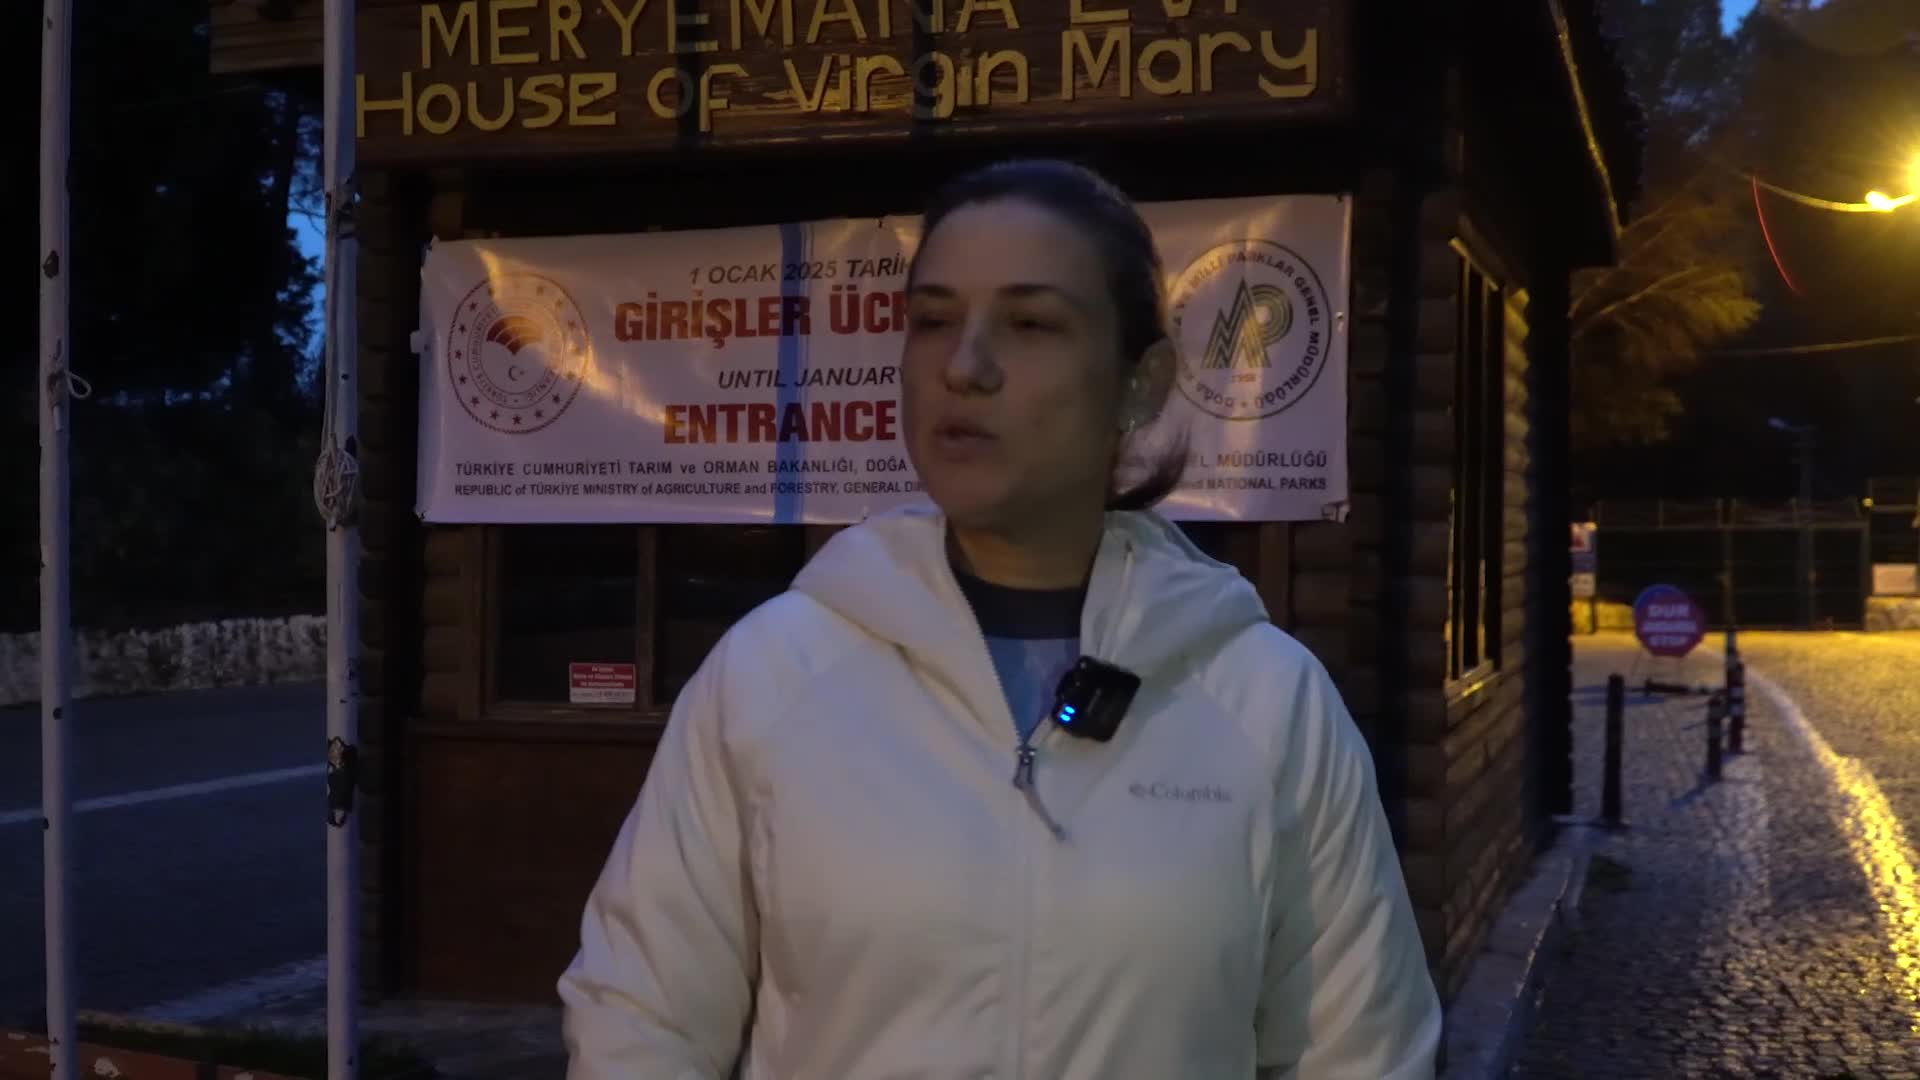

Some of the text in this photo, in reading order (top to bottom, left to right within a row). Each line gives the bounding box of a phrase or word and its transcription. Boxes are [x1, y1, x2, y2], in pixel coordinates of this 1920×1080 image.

[1061, 27, 1318, 101] Mary
[690, 267, 700, 284] 1
[708, 264, 777, 284] OCAK
[784, 260, 838, 282] 2025
[614, 289, 812, 350] GİRİŞLER
[718, 370, 787, 390] UNTIL
[663, 400, 897, 445] ENTRANCE
[456, 456, 908, 476] TÜRKİYE CUMHURİYETİ TARIM ve ORMAN BAKANLIĞI, DOĞA
[1217, 451, 1328, 468] MÜDÜRLÜĞÜ
[455, 483, 512, 497] REPUBLIC
[515, 483, 528, 496] of
[530, 481, 580, 496] TÜRKİYE
[583, 482, 638, 496] MINISTRY
[641, 482, 654, 495] of
[655, 481, 741, 495] AGRICULTURE
[744, 482, 767, 495] and
[843, 480, 902, 494] GENERAL
[1207, 477, 1276, 491] NATIONAL
[1279, 476, 1327, 491] PARKS
